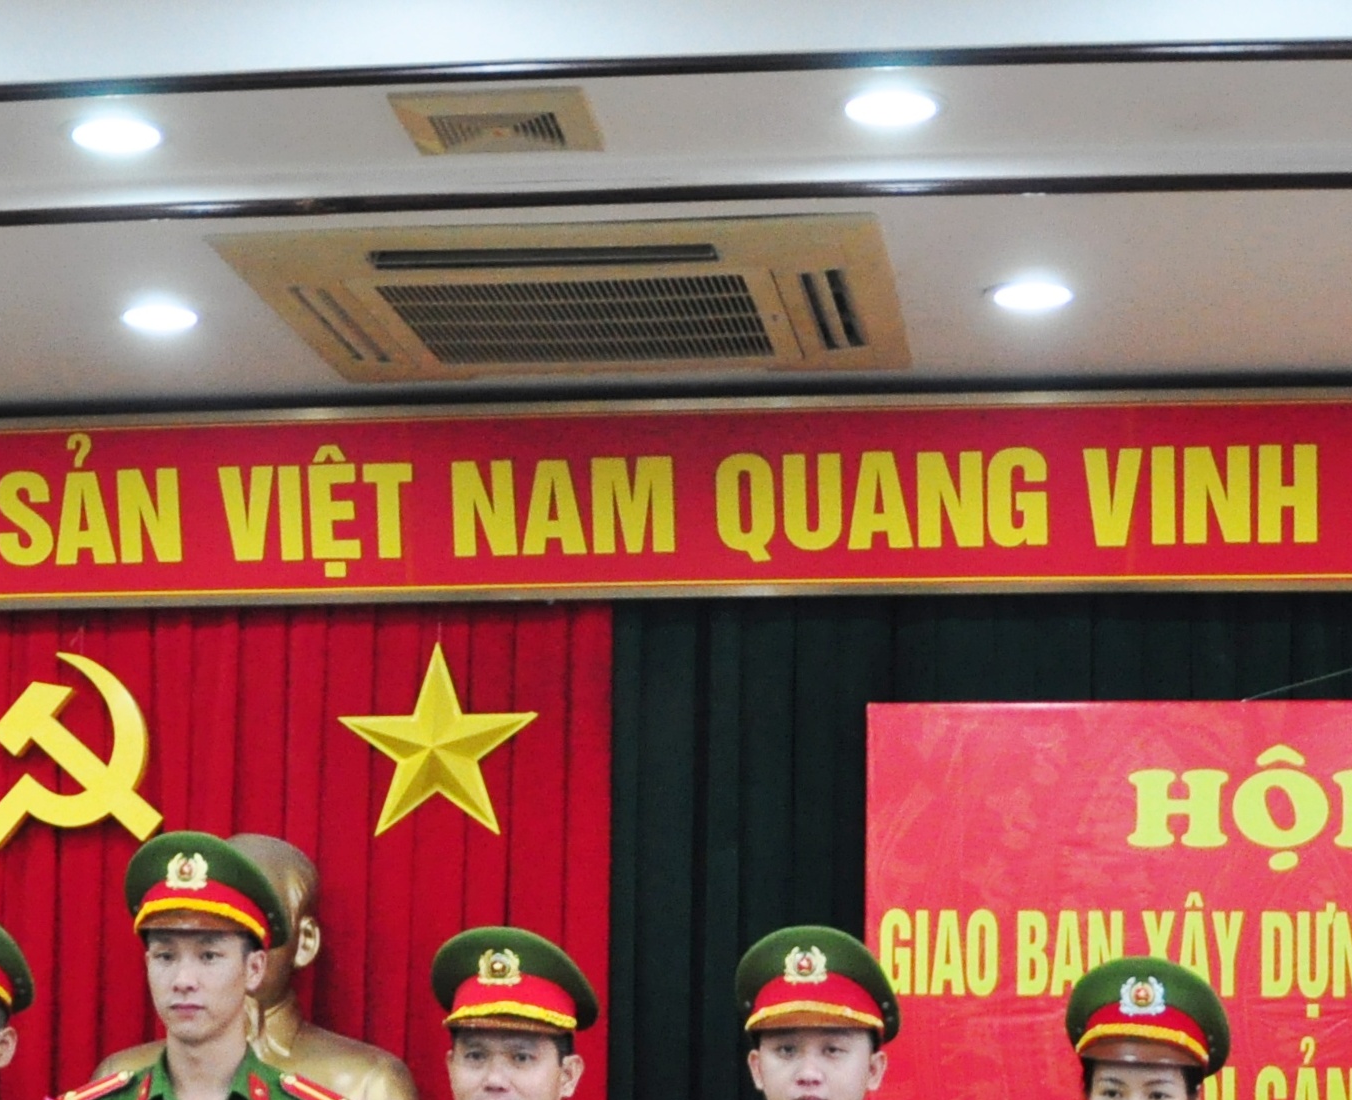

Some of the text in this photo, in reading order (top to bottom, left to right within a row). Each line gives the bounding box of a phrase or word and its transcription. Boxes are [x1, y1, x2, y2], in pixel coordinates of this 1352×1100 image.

[218, 445, 413, 578] VIỆT
[451, 456, 675, 557] NAM
[715, 447, 1050, 564] QUANG
[1083, 443, 1319, 548] VINH
[879, 907, 1000, 998] GIAO
[1016, 909, 1125, 998] BAN
[1141, 890, 1244, 999] XÂY
